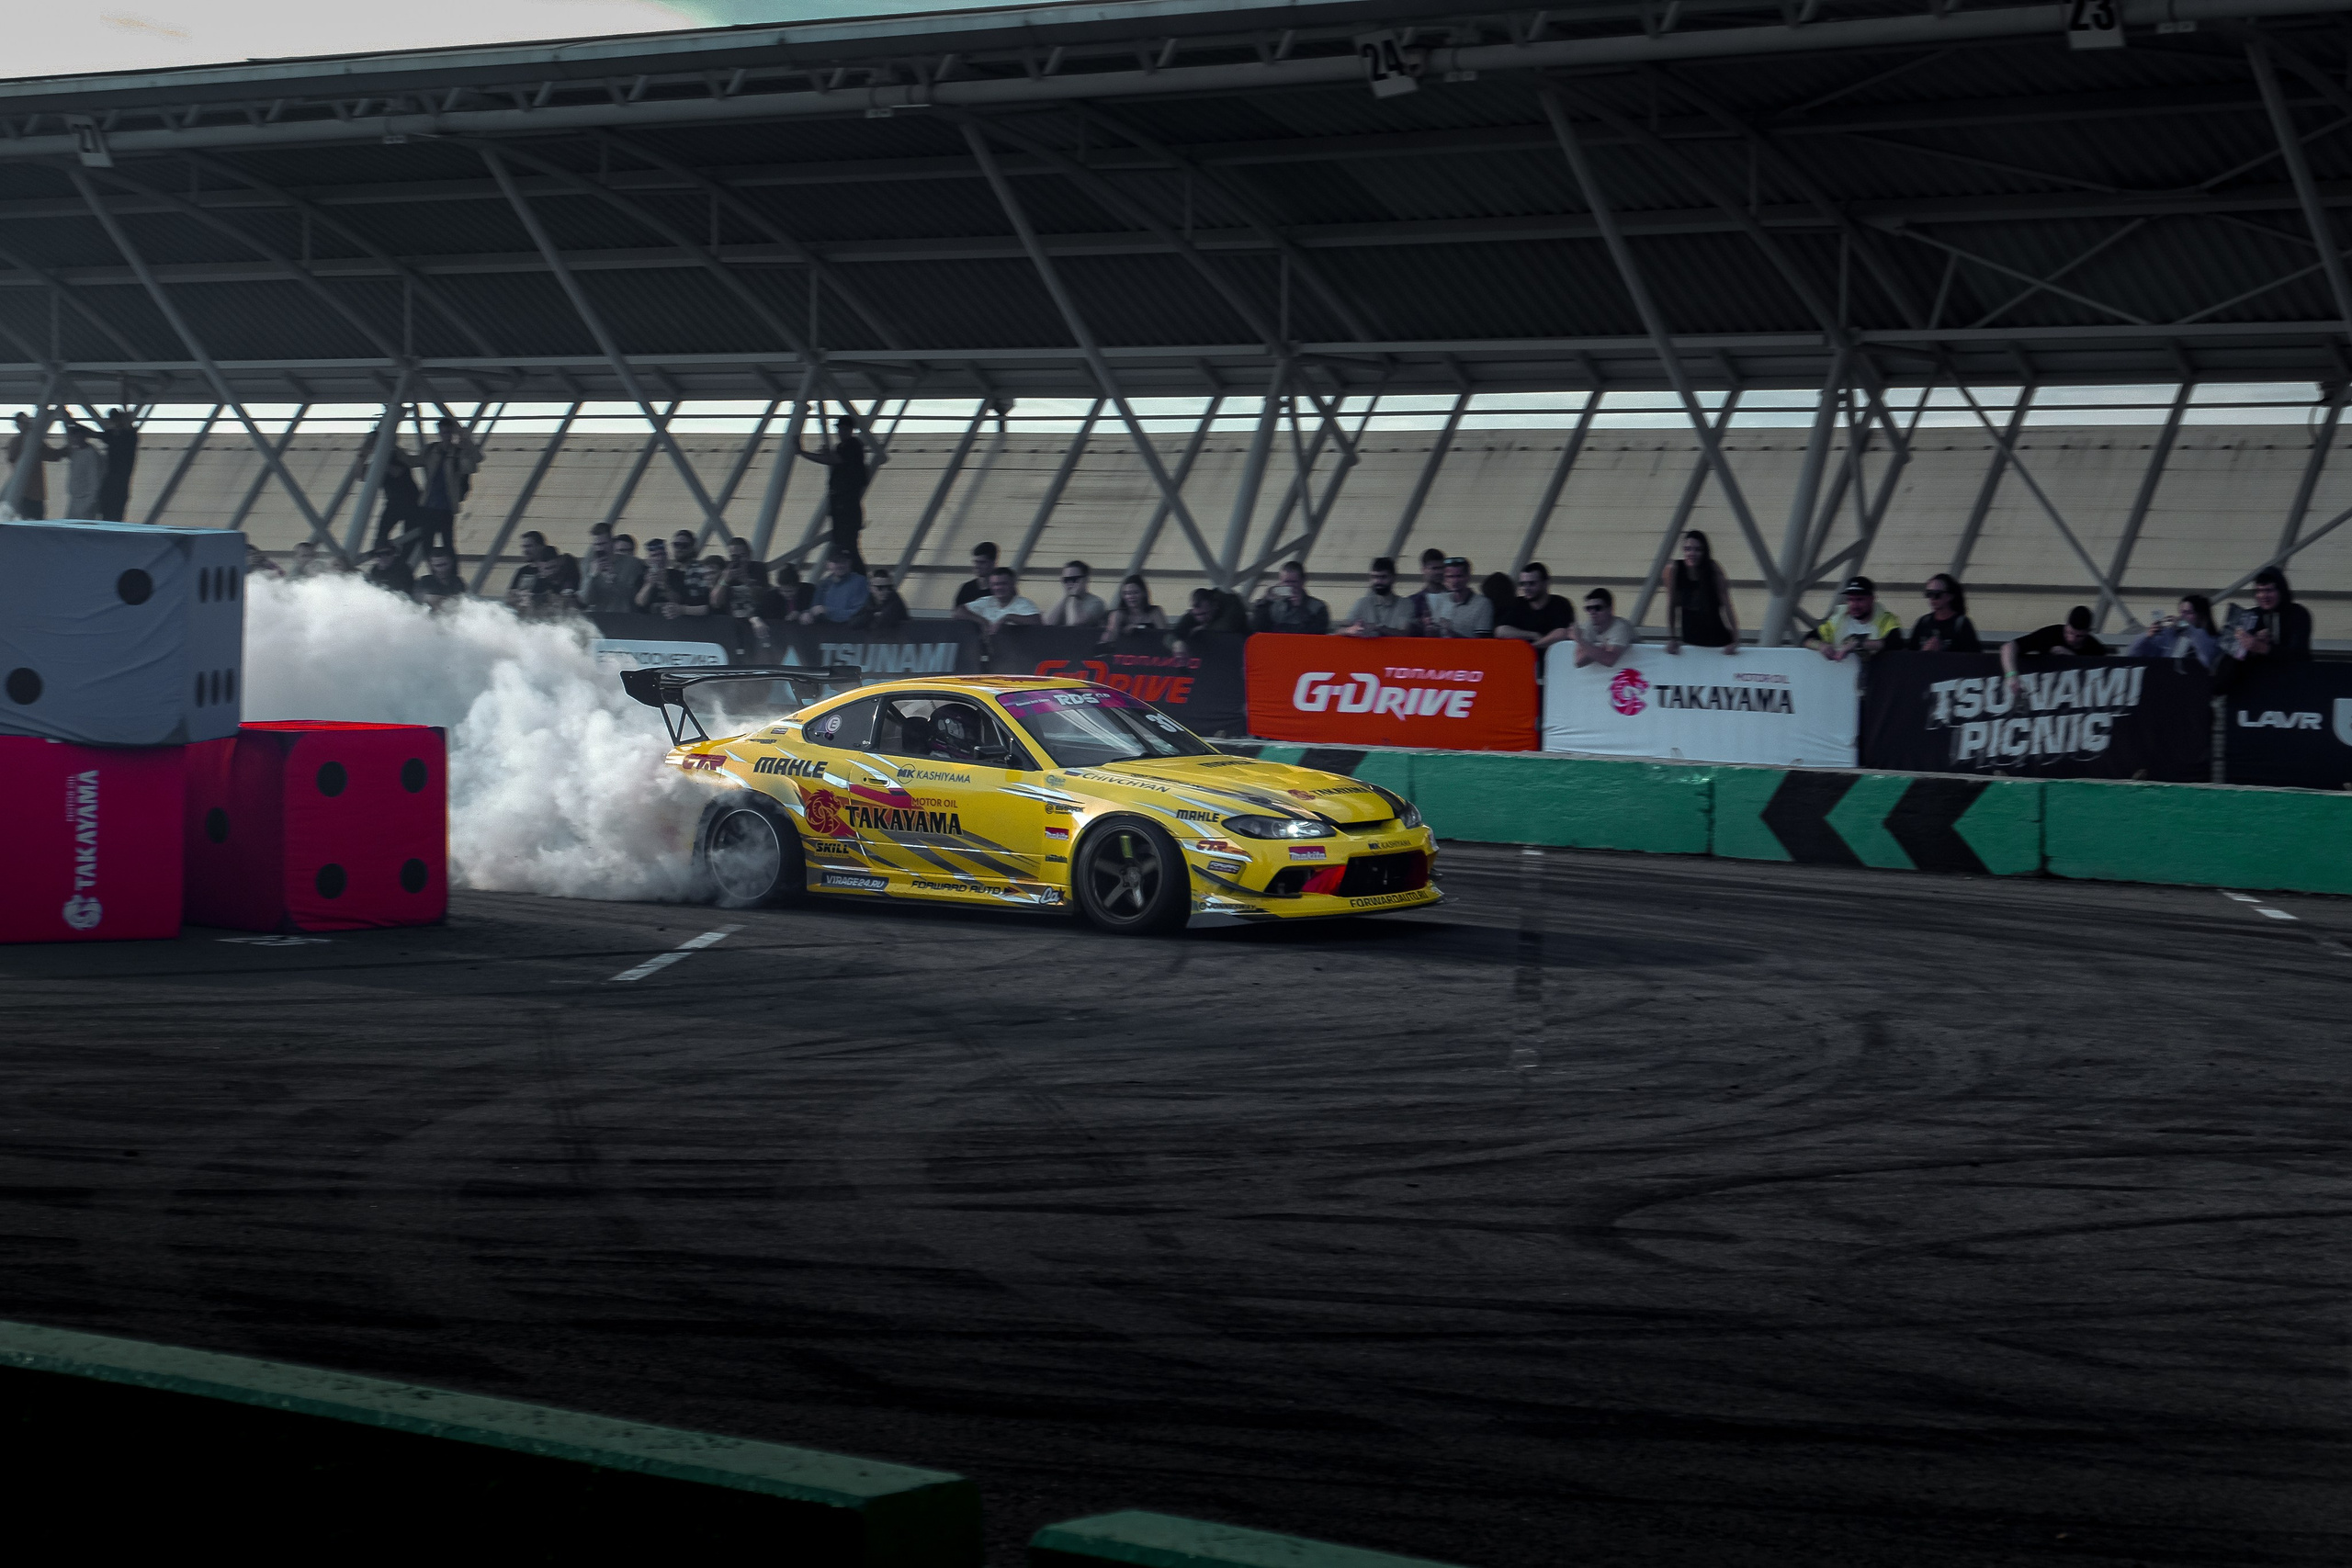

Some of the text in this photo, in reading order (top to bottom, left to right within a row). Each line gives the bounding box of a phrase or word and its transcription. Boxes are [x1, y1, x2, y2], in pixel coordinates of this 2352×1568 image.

[2071, 0, 2114, 30] 23
[1362, 39, 1406, 81] 24
[818, 643, 959, 672] TSUNAMI
[1384, 667, 1484, 682] ТОПЛИВО
[1052, 693, 1100, 705] RDS
[1654, 684, 1795, 714] TAKAYAMA
[1929, 666, 2148, 722] TSUNAMI
[2236, 710, 2324, 730] LAVR
[1958, 713, 2113, 760] PICNIC
[753, 757, 828, 778] MAHLE
[917, 770, 971, 784] KASHIYAMA
[1082, 773, 1171, 793] CHIVCHYAN
[1309, 786, 1374, 796] TAKAYAMA
[911, 797, 958, 808] MOTOR OIL
[845, 805, 964, 836] TAKAYAMA
[1176, 809, 1220, 822] MAHLE
[74, 770, 99, 891] TAKAYAMA
[827, 875, 885, 889] VIRAGE24.RU
[911, 880, 1001, 895] FORWARD AUTO
[1350, 890, 1430, 908] FORWARDAUTO.RU
